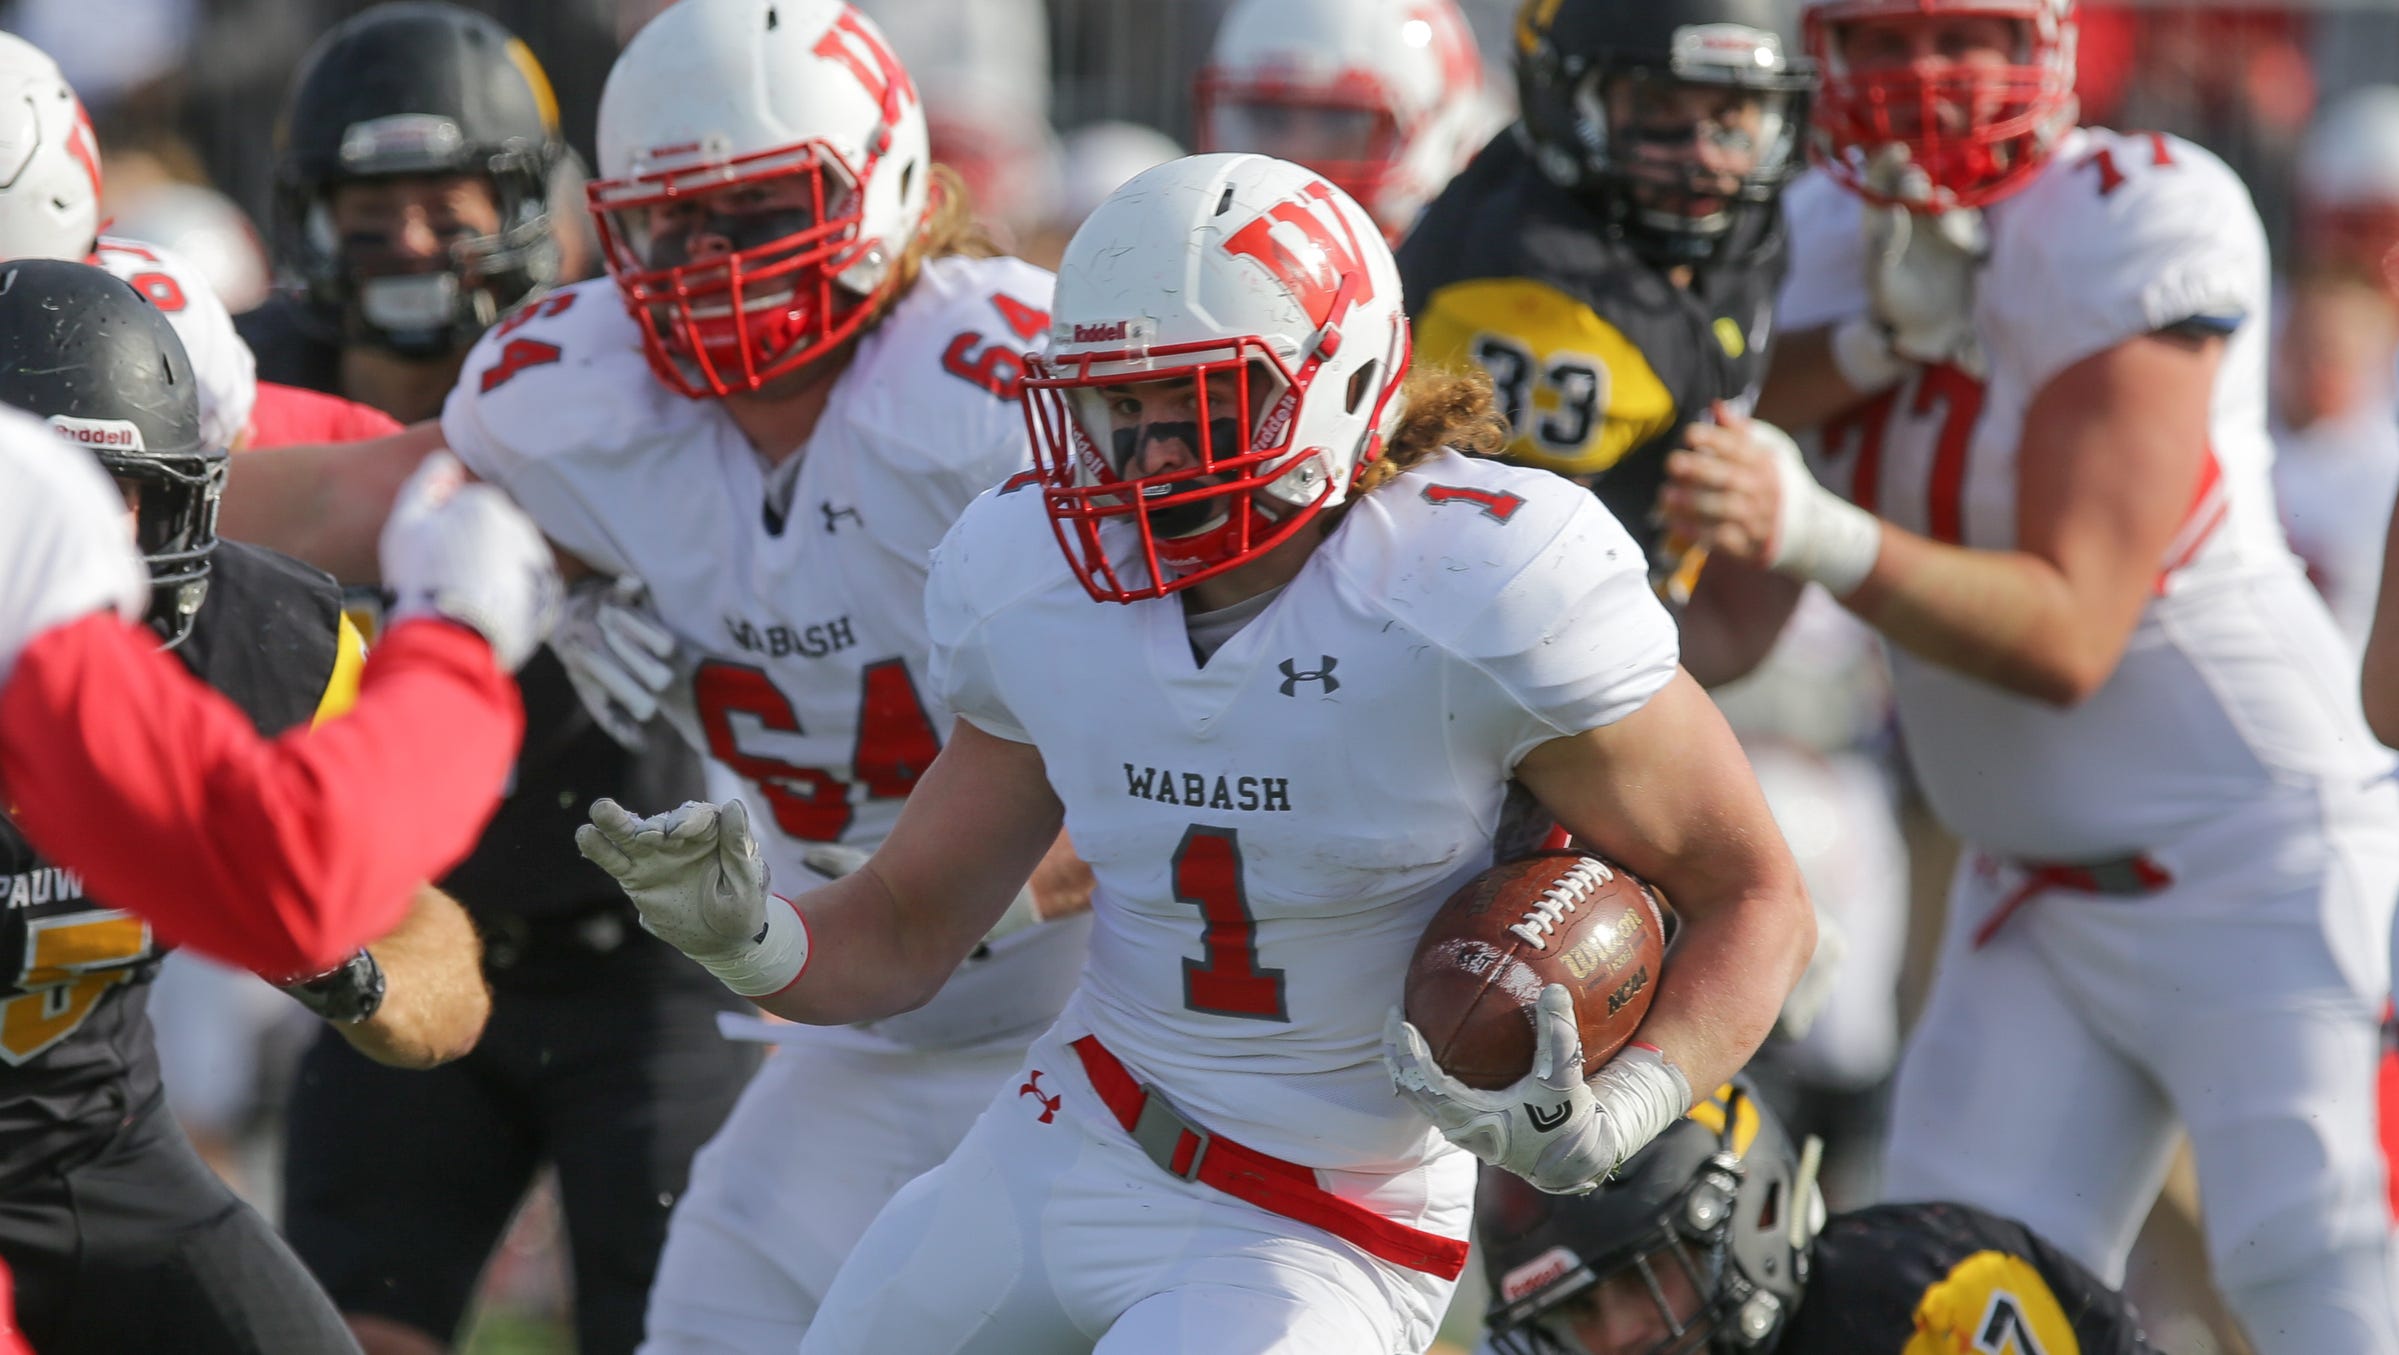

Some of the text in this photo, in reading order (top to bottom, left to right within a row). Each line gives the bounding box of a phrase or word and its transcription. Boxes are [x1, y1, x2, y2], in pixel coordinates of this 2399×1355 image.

[1474, 338, 1610, 454] 33
[1418, 482, 1529, 527] 1
[693, 656, 943, 845] 64
[1124, 763, 1292, 812] WABASH
[1170, 823, 1292, 1024] 1
